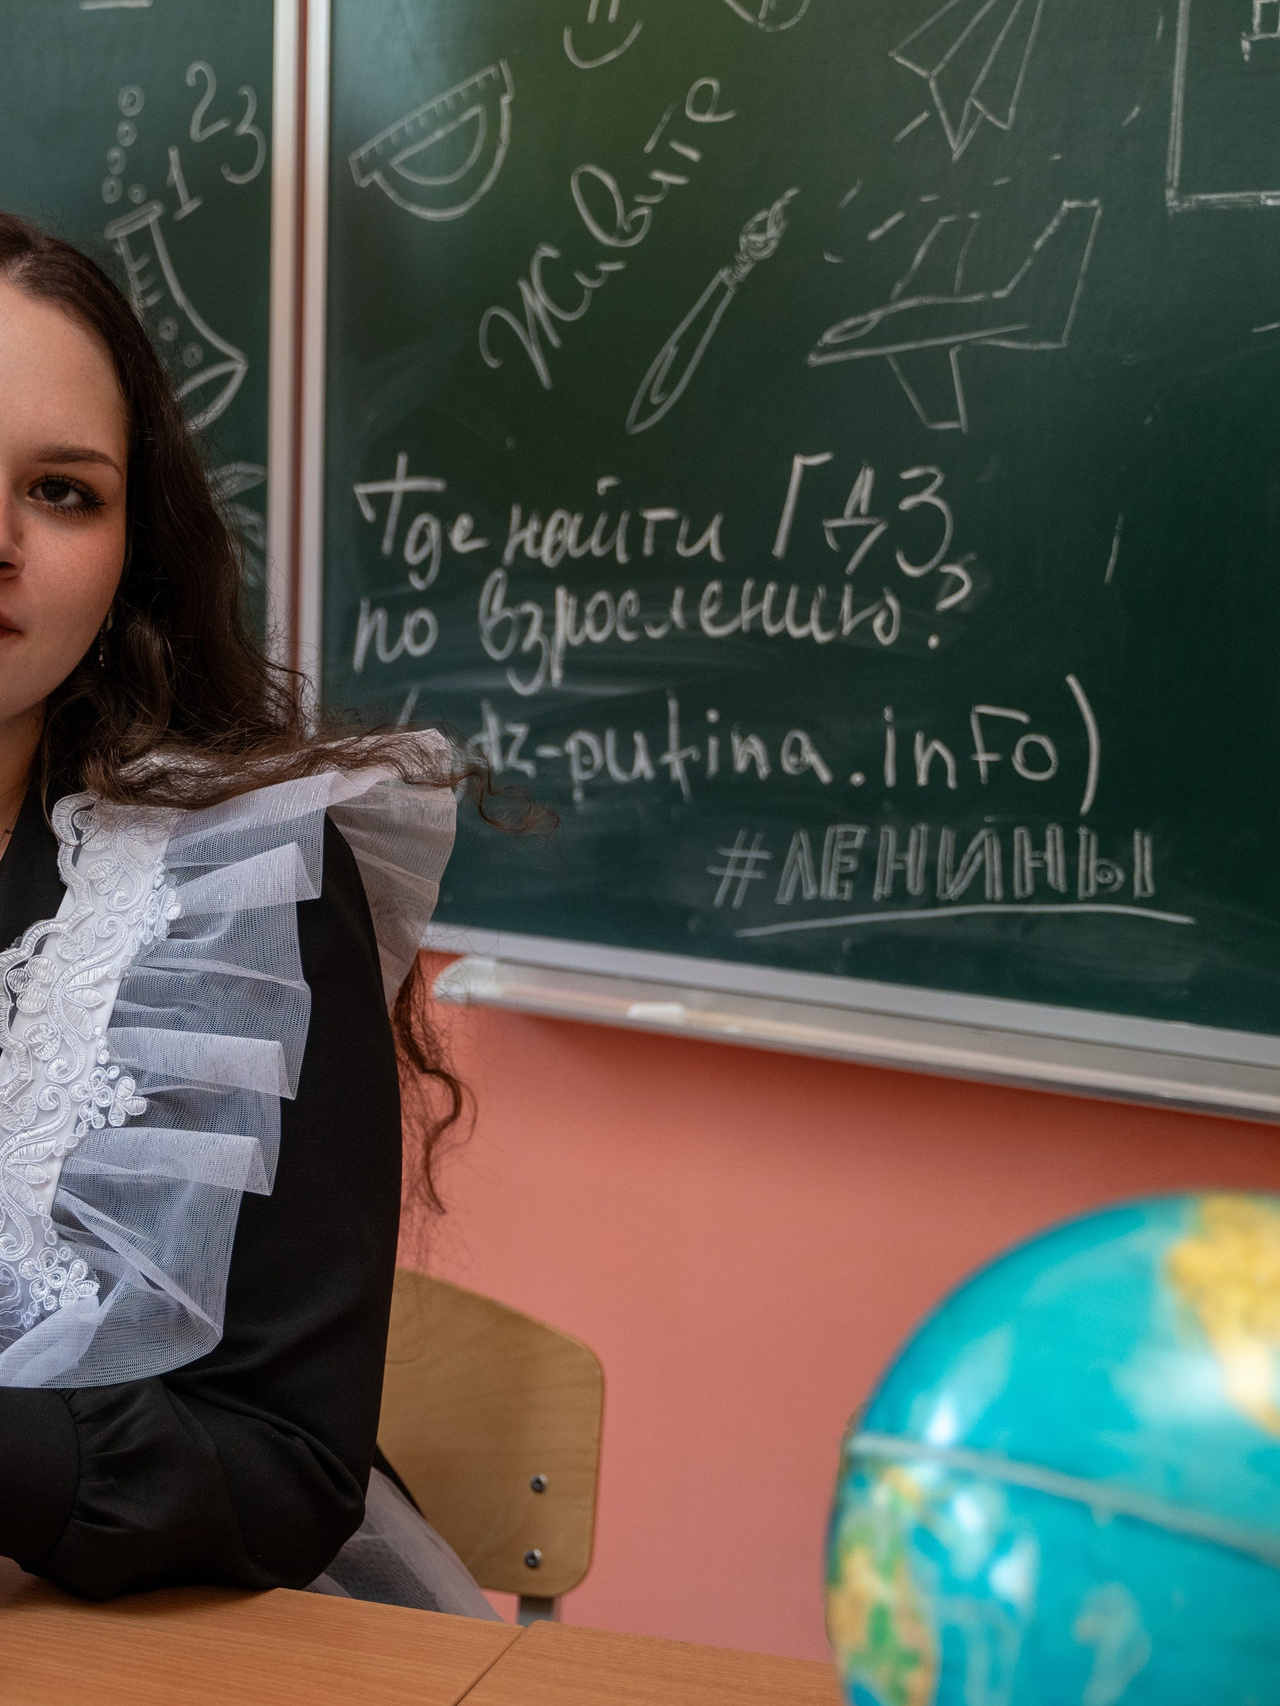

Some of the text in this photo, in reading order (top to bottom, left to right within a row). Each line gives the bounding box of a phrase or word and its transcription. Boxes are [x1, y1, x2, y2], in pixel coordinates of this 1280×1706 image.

[478, 76, 738, 390] Живите
[502, 475, 726, 568] найти
[353, 599, 439, 673] по
